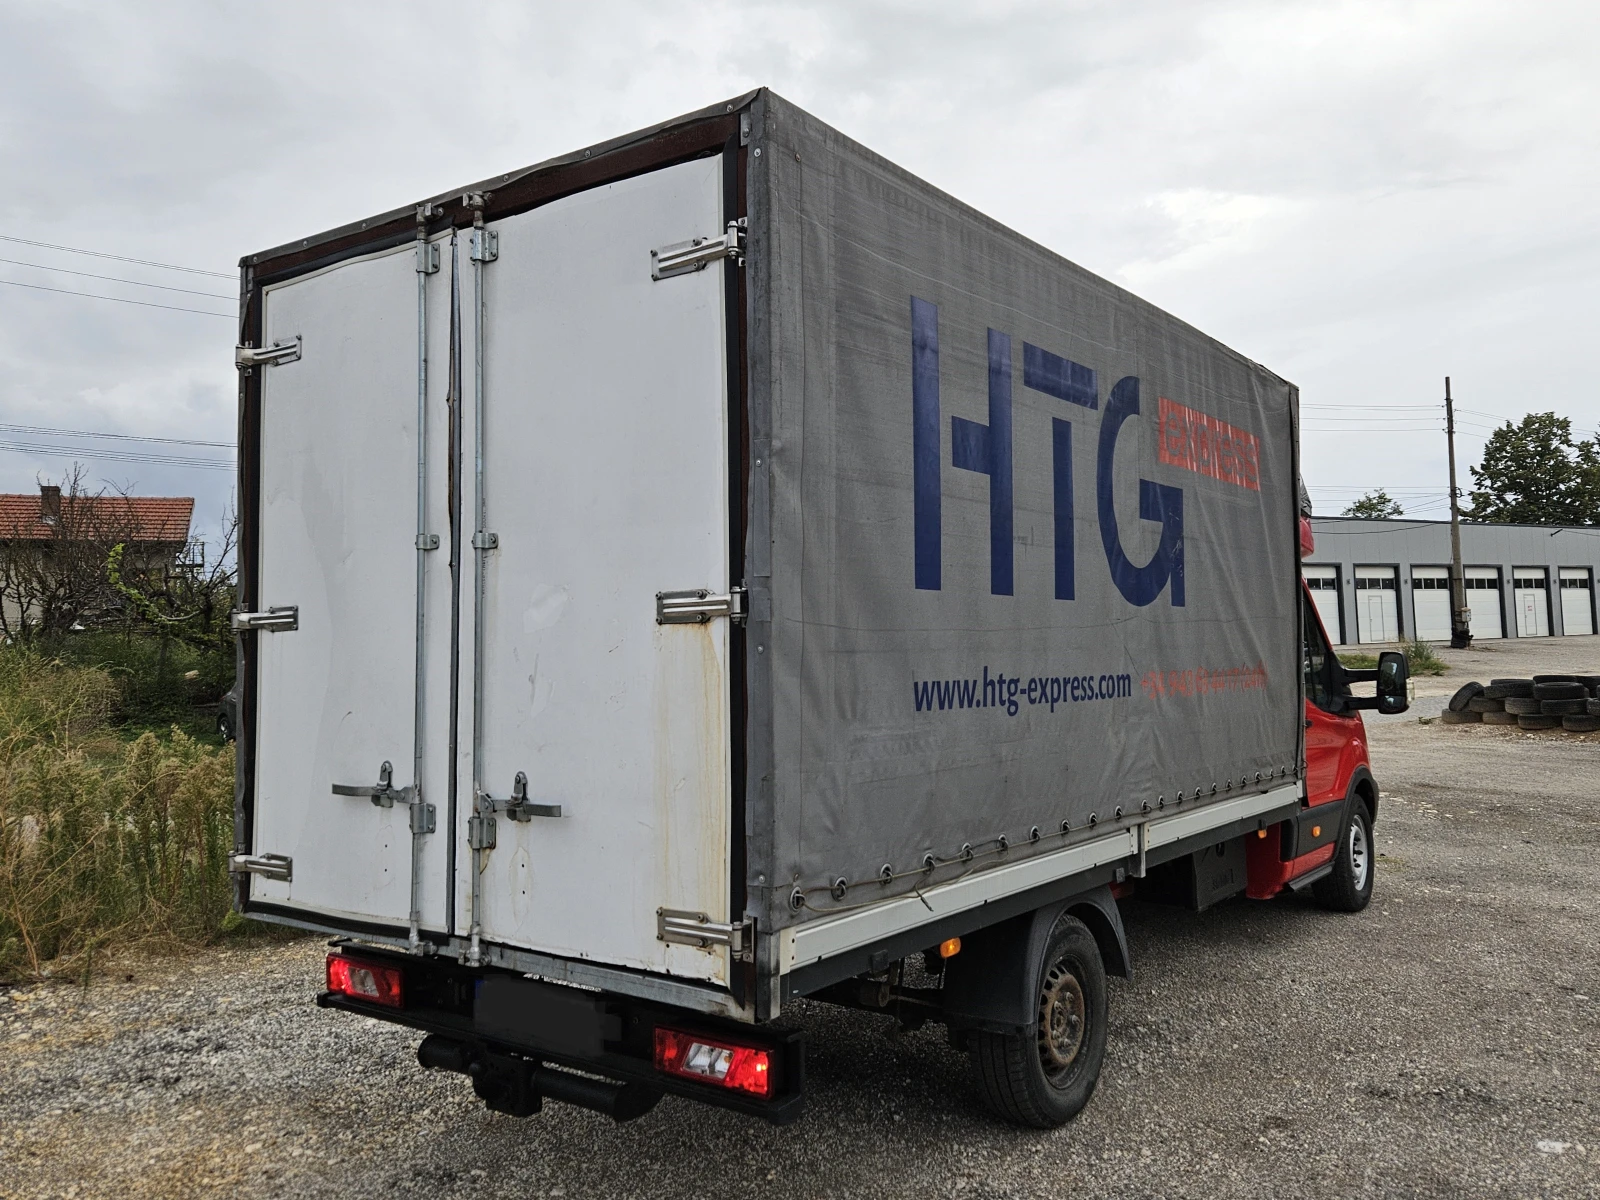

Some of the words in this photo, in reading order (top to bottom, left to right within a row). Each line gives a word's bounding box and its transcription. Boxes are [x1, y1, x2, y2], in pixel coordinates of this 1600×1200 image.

[911, 295, 1185, 607] HTG
[1165, 410, 1259, 484] express
[913, 666, 1132, 716] www.htg-express.com
